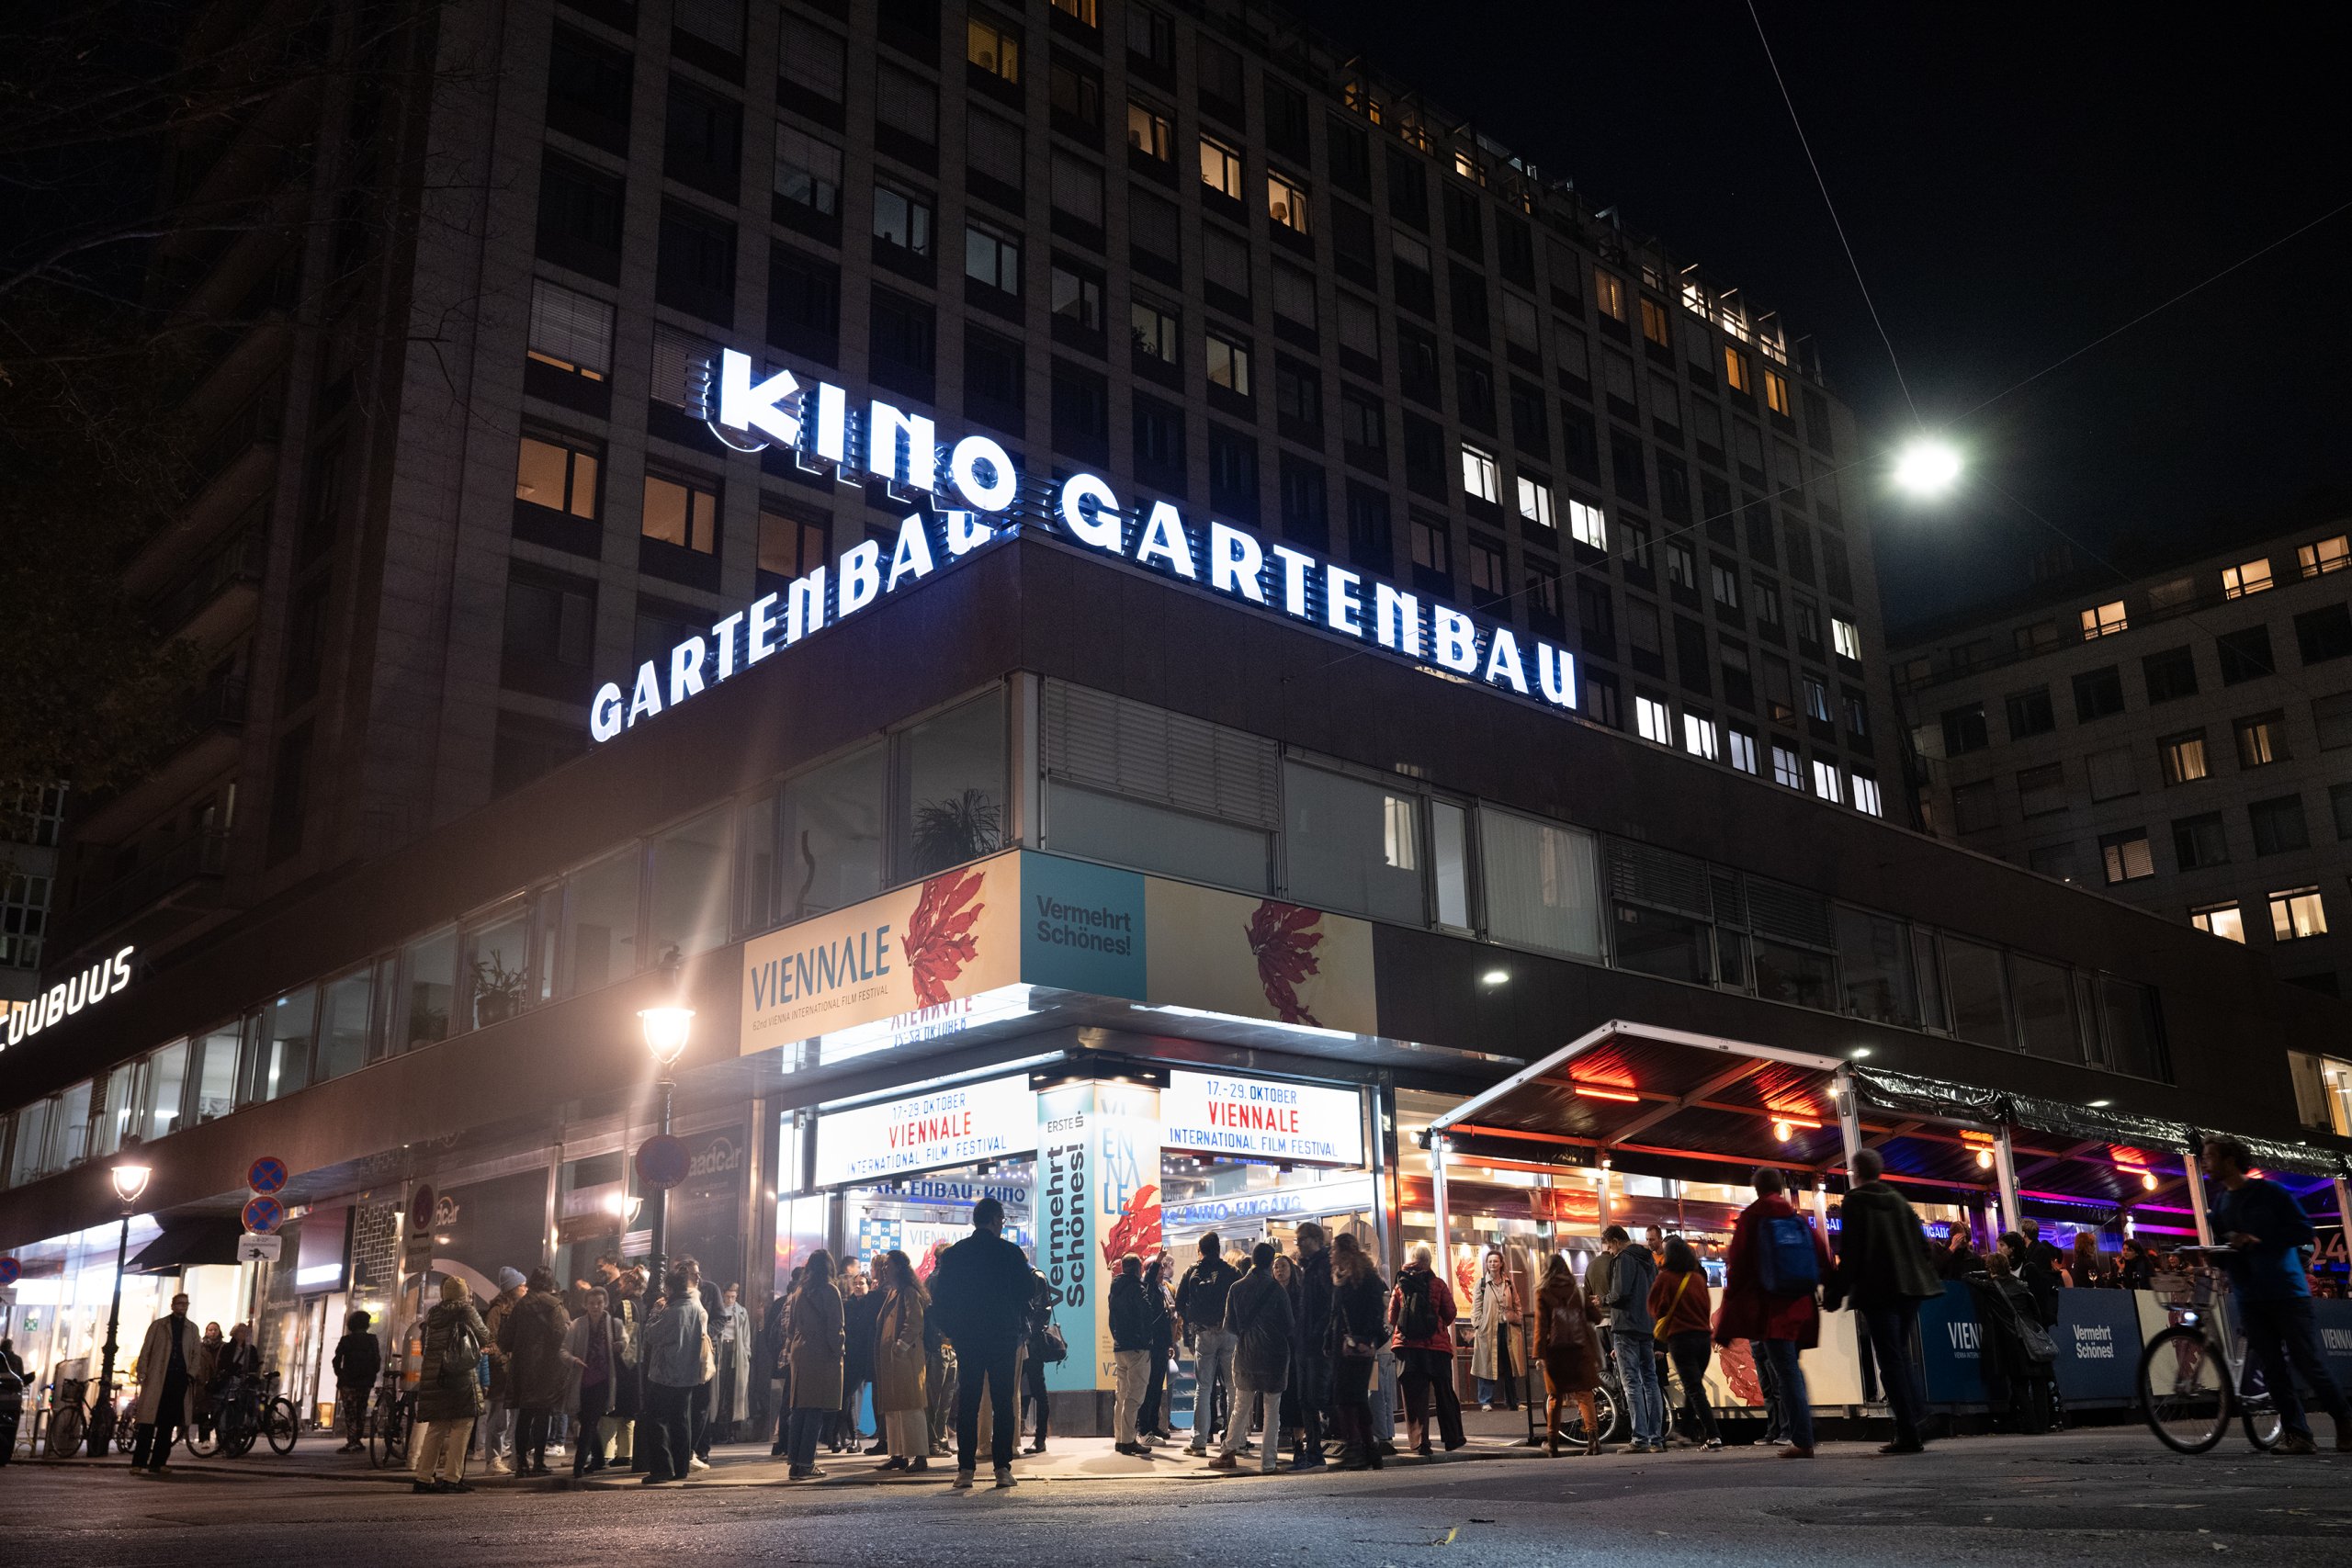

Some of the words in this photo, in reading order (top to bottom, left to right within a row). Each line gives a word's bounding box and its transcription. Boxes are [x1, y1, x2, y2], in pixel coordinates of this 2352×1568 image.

[719, 348, 1017, 512] KINO
[1060, 472, 1577, 710] GARTENBAU
[1036, 895, 1131, 932] Vermehrt
[1037, 920, 1131, 955] Schönes!
[751, 924, 890, 1012] VIENNALE
[752, 1020, 767, 1032] 62nd
[768, 1013, 791, 1029] VIENNA
[791, 998, 841, 1021] INTERNATIONAL
[841, 993, 857, 1008] FILM
[858, 985, 888, 1002] FESTIVAL
[923, 1092, 966, 1114] OKTOBER
[1250, 1086, 1297, 1104] OKTOBER
[889, 1111, 971, 1148] VIENNALE
[1047, 1118, 1073, 1134] ERSTE
[1208, 1101, 1299, 1134] VIENNALE
[847, 1151, 921, 1176] INTERNATIONAL
[926, 1147, 948, 1164] FILM
[956, 1134, 1007, 1157] FESTIVAL
[1170, 1127, 1256, 1150] INTERNATIONAL
[1261, 1136, 1286, 1153] FILM
[1292, 1139, 1339, 1157] FESTIVAL
[984, 1185, 1026, 1202] KINO
[1103, 1182, 1130, 1215] LE
[1046, 1145, 1064, 1307] Vermehrt
[1066, 1143, 1085, 1308] Schönes!
[2073, 1324, 2112, 1341] Vermehrt
[2075, 1342, 2114, 1359] Schönes!
